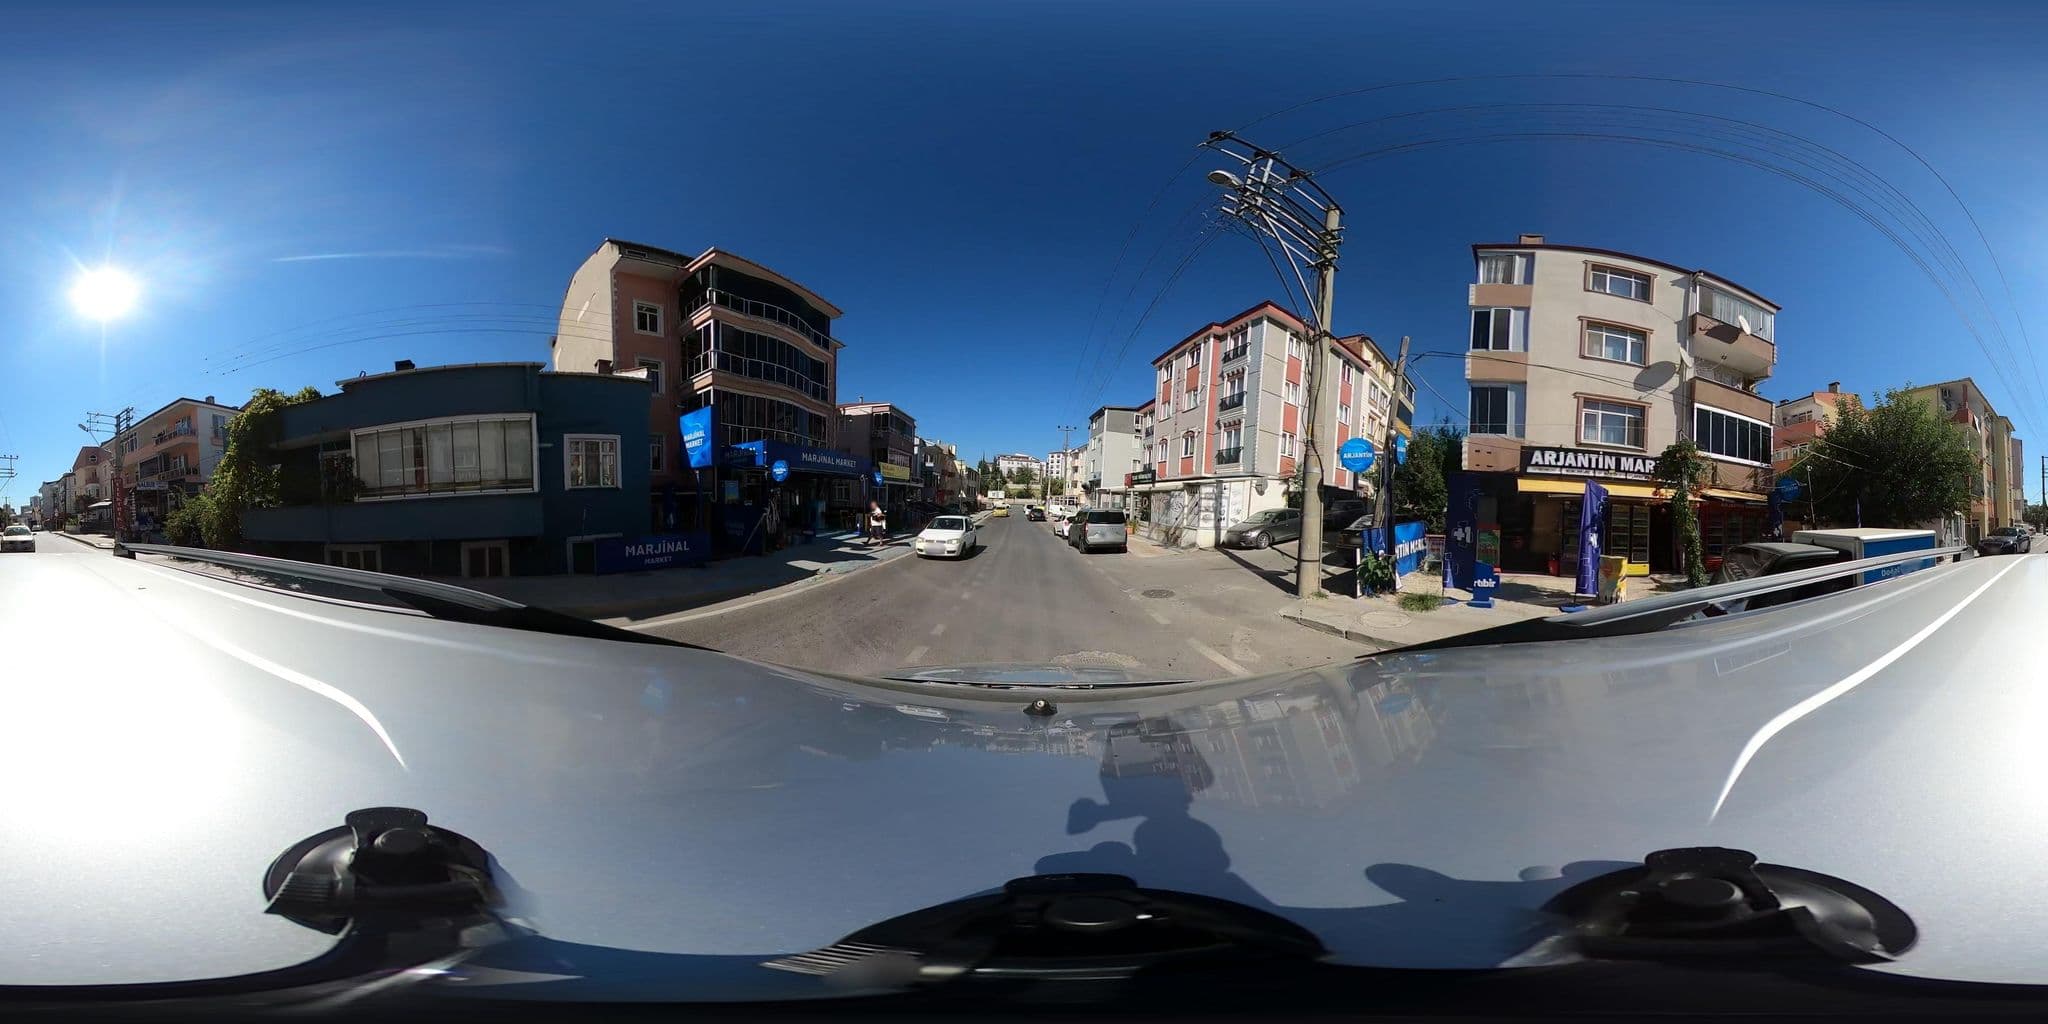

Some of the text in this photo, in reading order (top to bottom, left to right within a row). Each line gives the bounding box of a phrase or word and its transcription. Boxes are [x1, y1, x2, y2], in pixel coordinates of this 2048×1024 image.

[802, 452, 857, 468] MARJİNAL MARKET
[1343, 451, 1373, 459] ARJANTİN
[1530, 450, 1616, 470] ARJANTİN
[1620, 456, 1656, 474] MAR
[624, 540, 690, 558] MARJİNAL
[643, 555, 673, 566] MARKET
